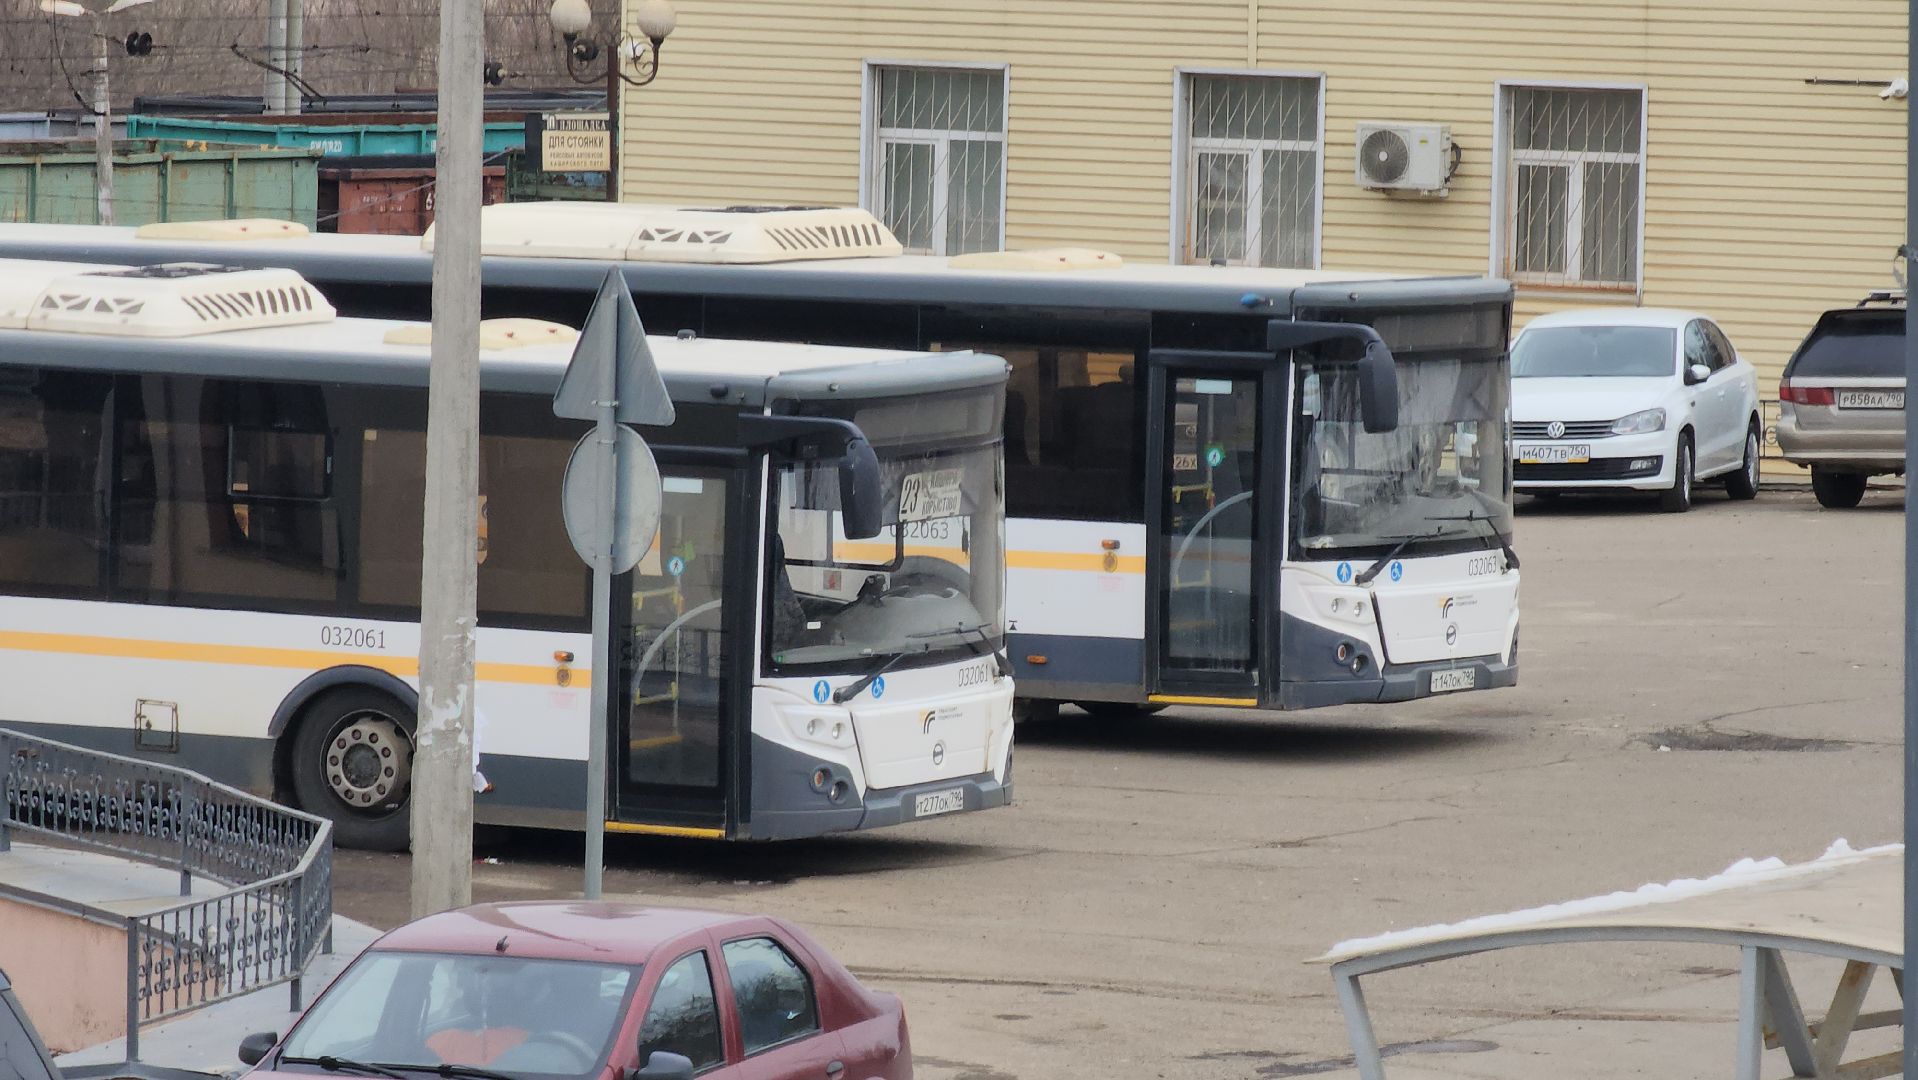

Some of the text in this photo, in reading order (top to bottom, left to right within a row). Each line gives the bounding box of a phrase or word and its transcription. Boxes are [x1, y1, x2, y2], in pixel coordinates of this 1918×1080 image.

[549, 135, 604, 150] ДЛЯ СТОЯНКИ
[1522, 446, 1587, 459] М407ТВ 750
[901, 478, 920, 515] 23
[1468, 555, 1497, 576] 032063
[321, 625, 386, 649] 032061
[958, 663, 989, 687] 032061
[919, 790, 963, 813] Т277ОК 790
